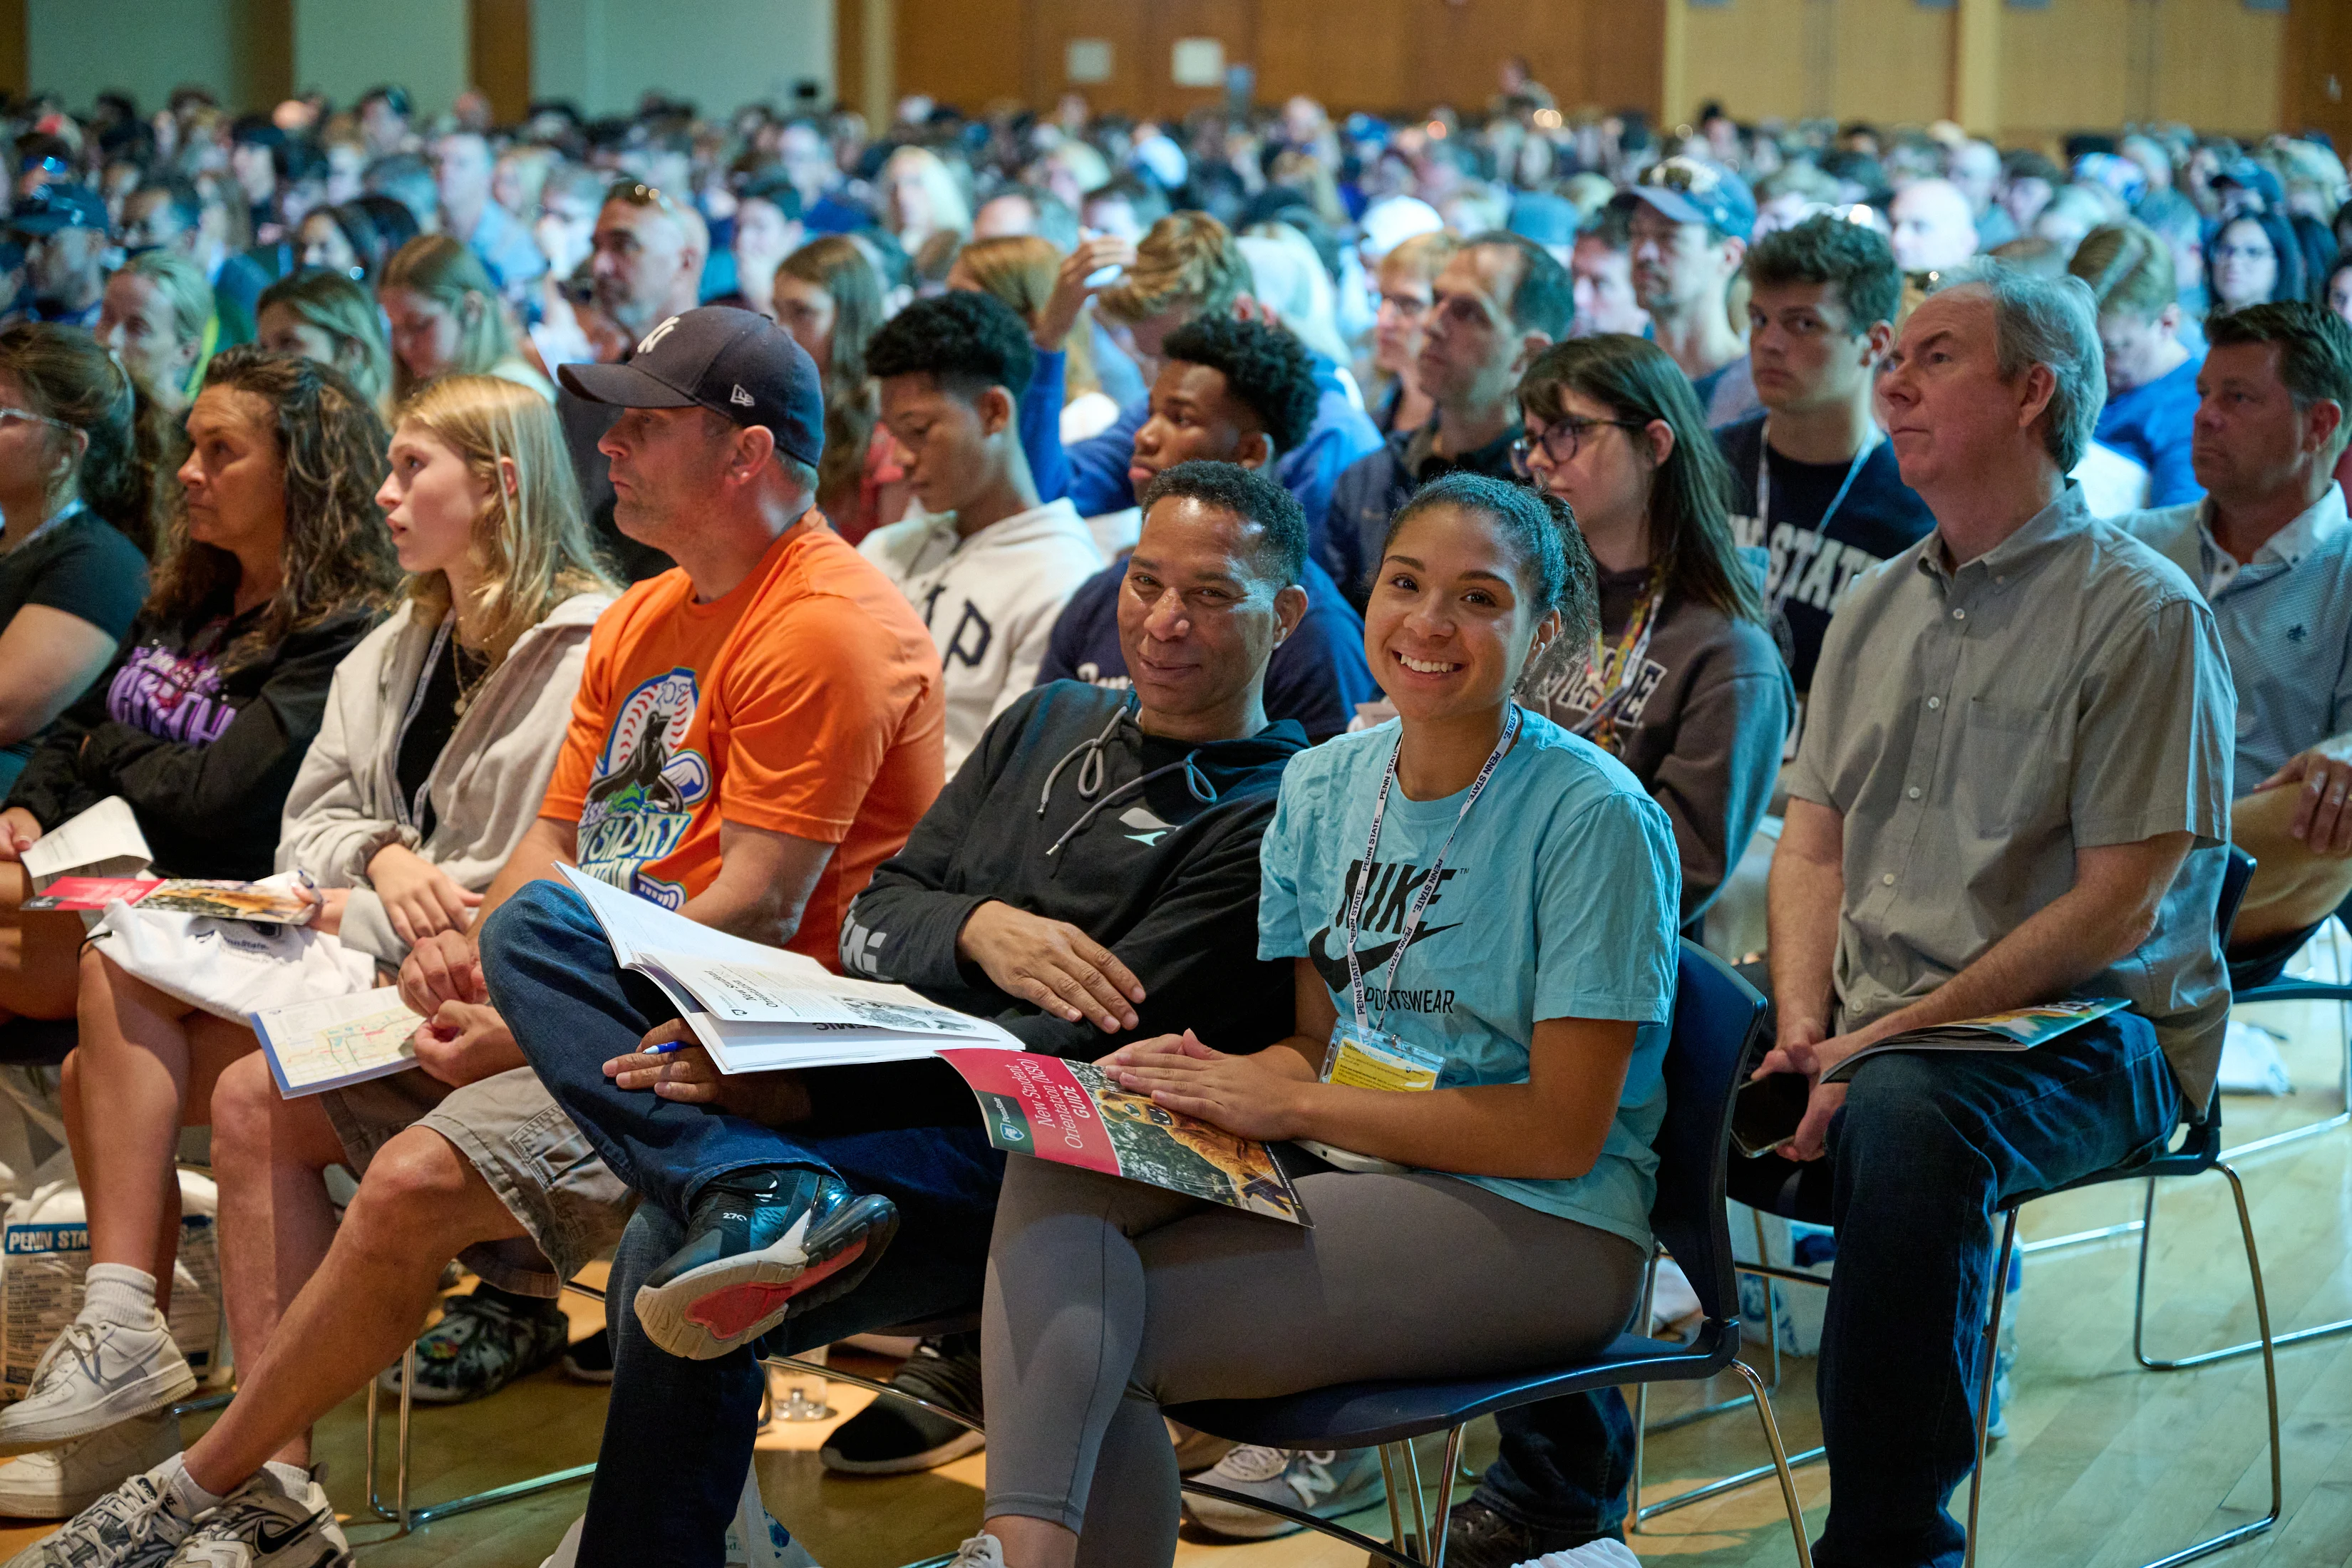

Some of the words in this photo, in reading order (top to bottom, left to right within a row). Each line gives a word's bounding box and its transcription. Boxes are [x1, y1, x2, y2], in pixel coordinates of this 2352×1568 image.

[1482, 751, 1502, 775] PENN
[1379, 775, 1391, 800] PENN
[1466, 774, 1487, 803] STATE.
[1362, 847, 1373, 872] PENN
[1368, 814, 1381, 845] STATE.
[1427, 857, 1443, 884] PENN
[1336, 859, 1458, 934] NIKE
[1351, 887, 1364, 917] STATE.
[1412, 884, 1433, 913] STATE.
[1349, 918, 1358, 944] PENN
[1398, 927, 1413, 951] PENN
[704, 969, 736, 989] Student
[1351, 956, 1363, 989] STATE.
[732, 979, 778, 1008] Orientation
[735, 988, 757, 1001] New
[1356, 989, 1366, 1015] PENN
[1364, 986, 1455, 1013] PORTSWEAR
[1343, 1041, 1362, 1053] Welcome
[1367, 1051, 1378, 1060] Penn
[1004, 1063, 1041, 1100] Student
[1016, 1058, 1053, 1085] (NSO)
[993, 1097, 1011, 1123] PennState
[1033, 1100, 1056, 1128] New
[1058, 1083, 1090, 1119] GUIDE
[1043, 1084, 1083, 1149] Orientation
[8, 1231, 54, 1252] PENN
